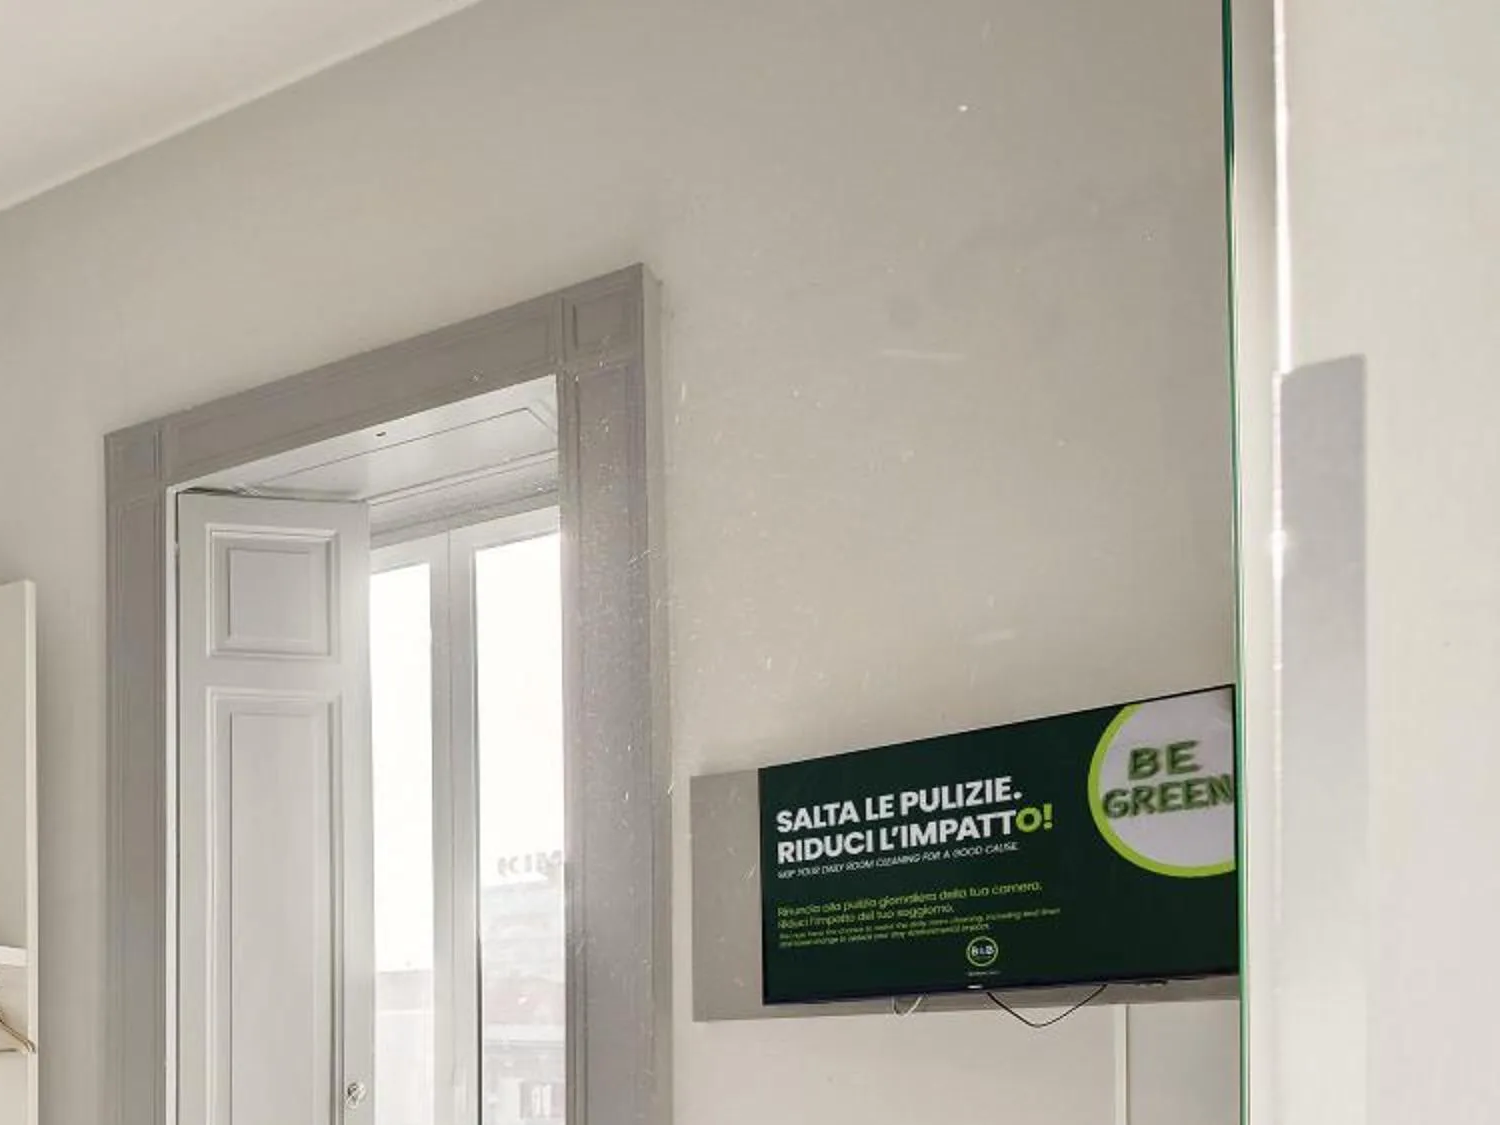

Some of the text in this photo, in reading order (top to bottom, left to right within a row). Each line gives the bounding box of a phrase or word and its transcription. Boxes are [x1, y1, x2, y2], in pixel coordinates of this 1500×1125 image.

[1128, 740, 1202, 780] BE
[776, 776, 1023, 833] SALTA LE PULIZIE.
[1102, 773, 1233, 818] GREEN
[777, 803, 1053, 865] RIDUCI L'IMPATTO!
